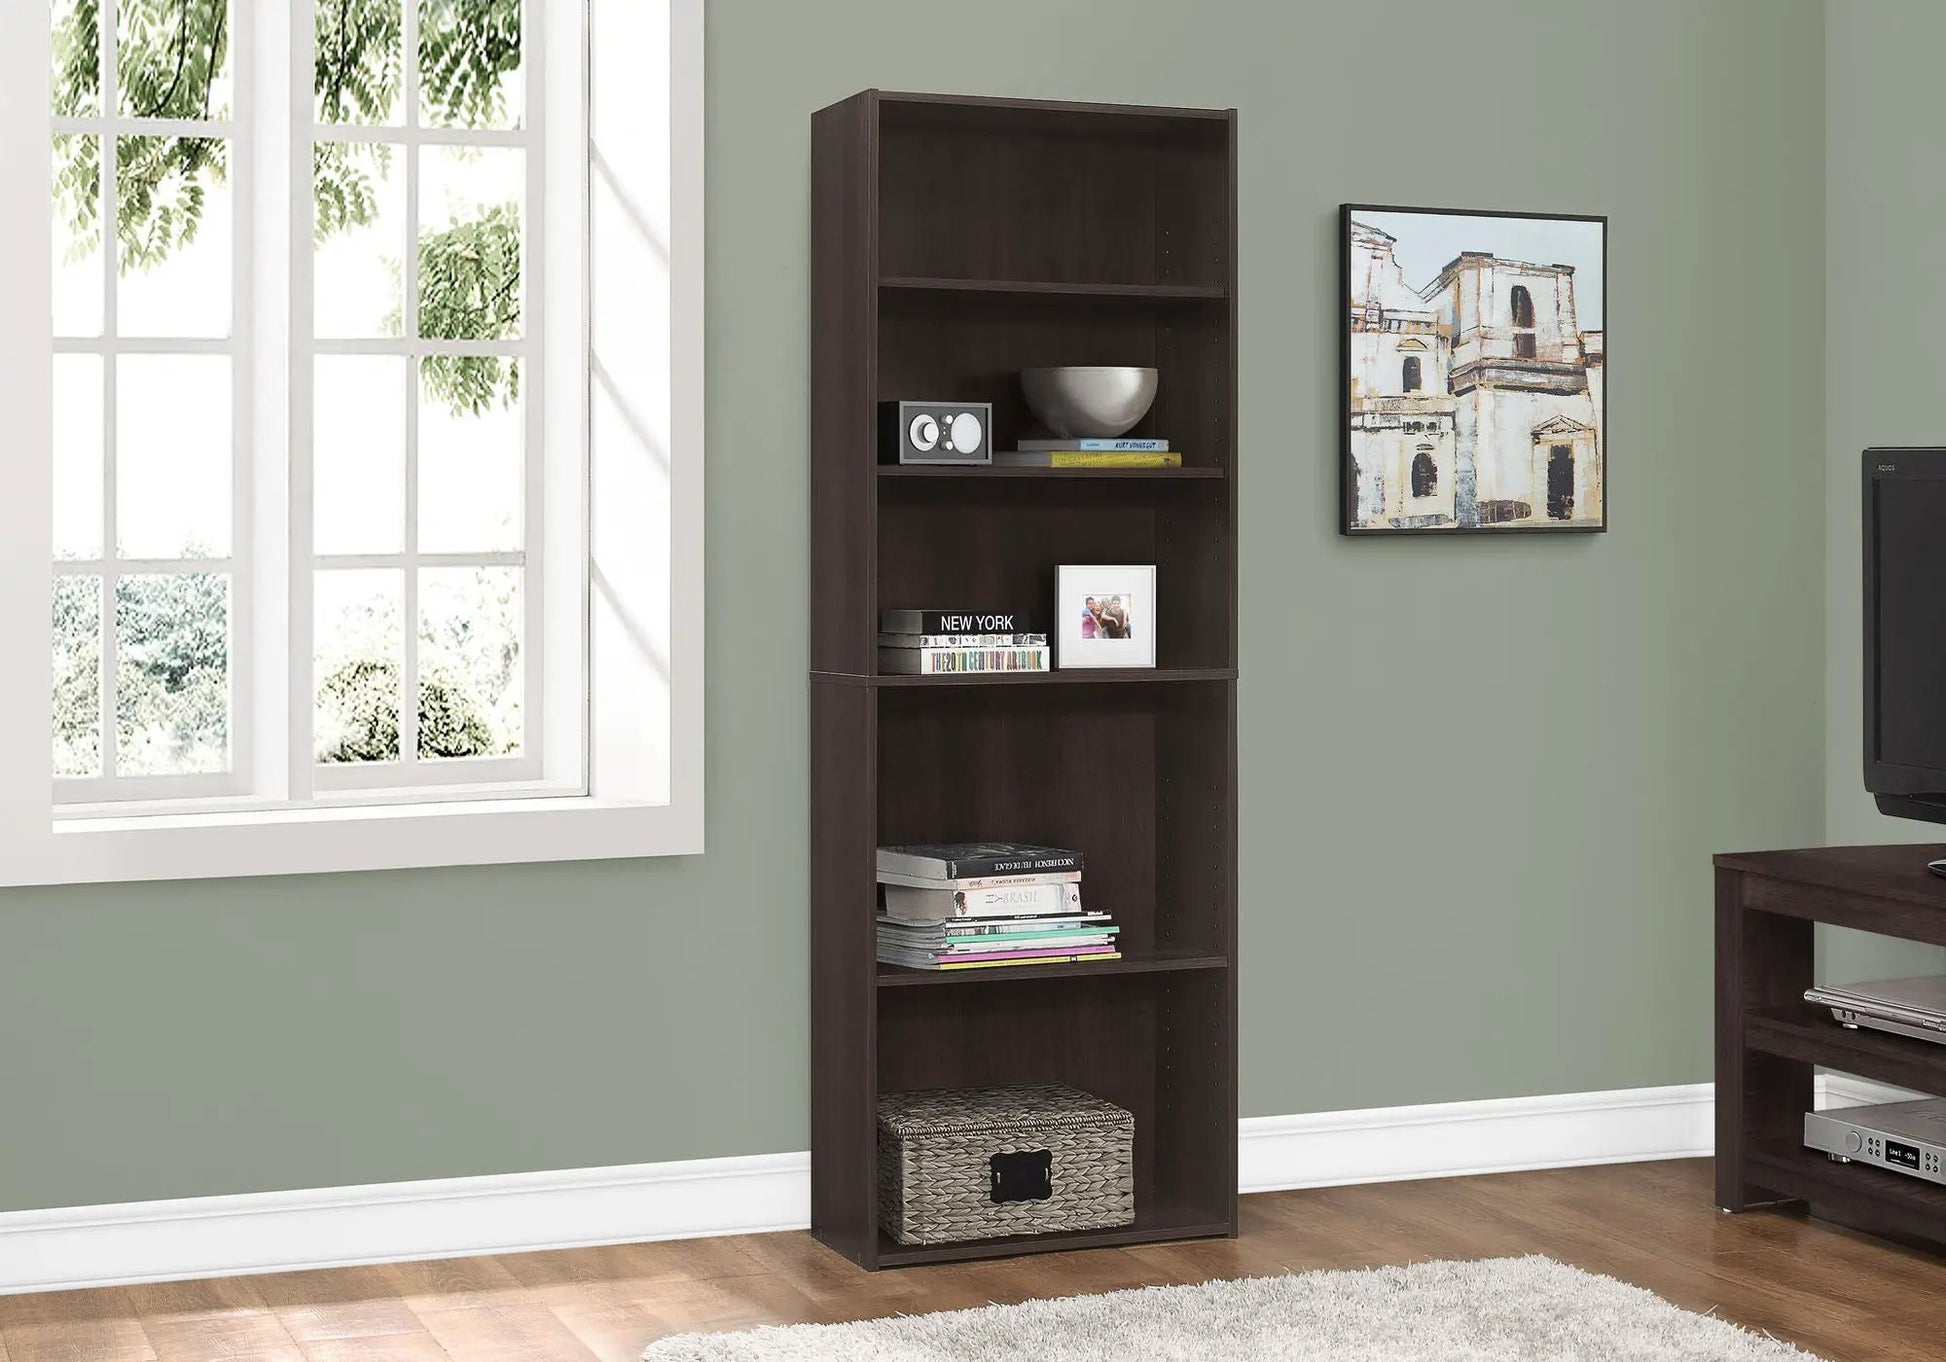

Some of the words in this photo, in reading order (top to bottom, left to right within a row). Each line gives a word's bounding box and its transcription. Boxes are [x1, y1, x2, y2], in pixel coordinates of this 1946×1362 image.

[1115, 441, 1129, 449] KURT
[1130, 441, 1156, 449] VONNEGUT
[941, 616, 973, 631] NEW
[976, 615, 1014, 630] YORK
